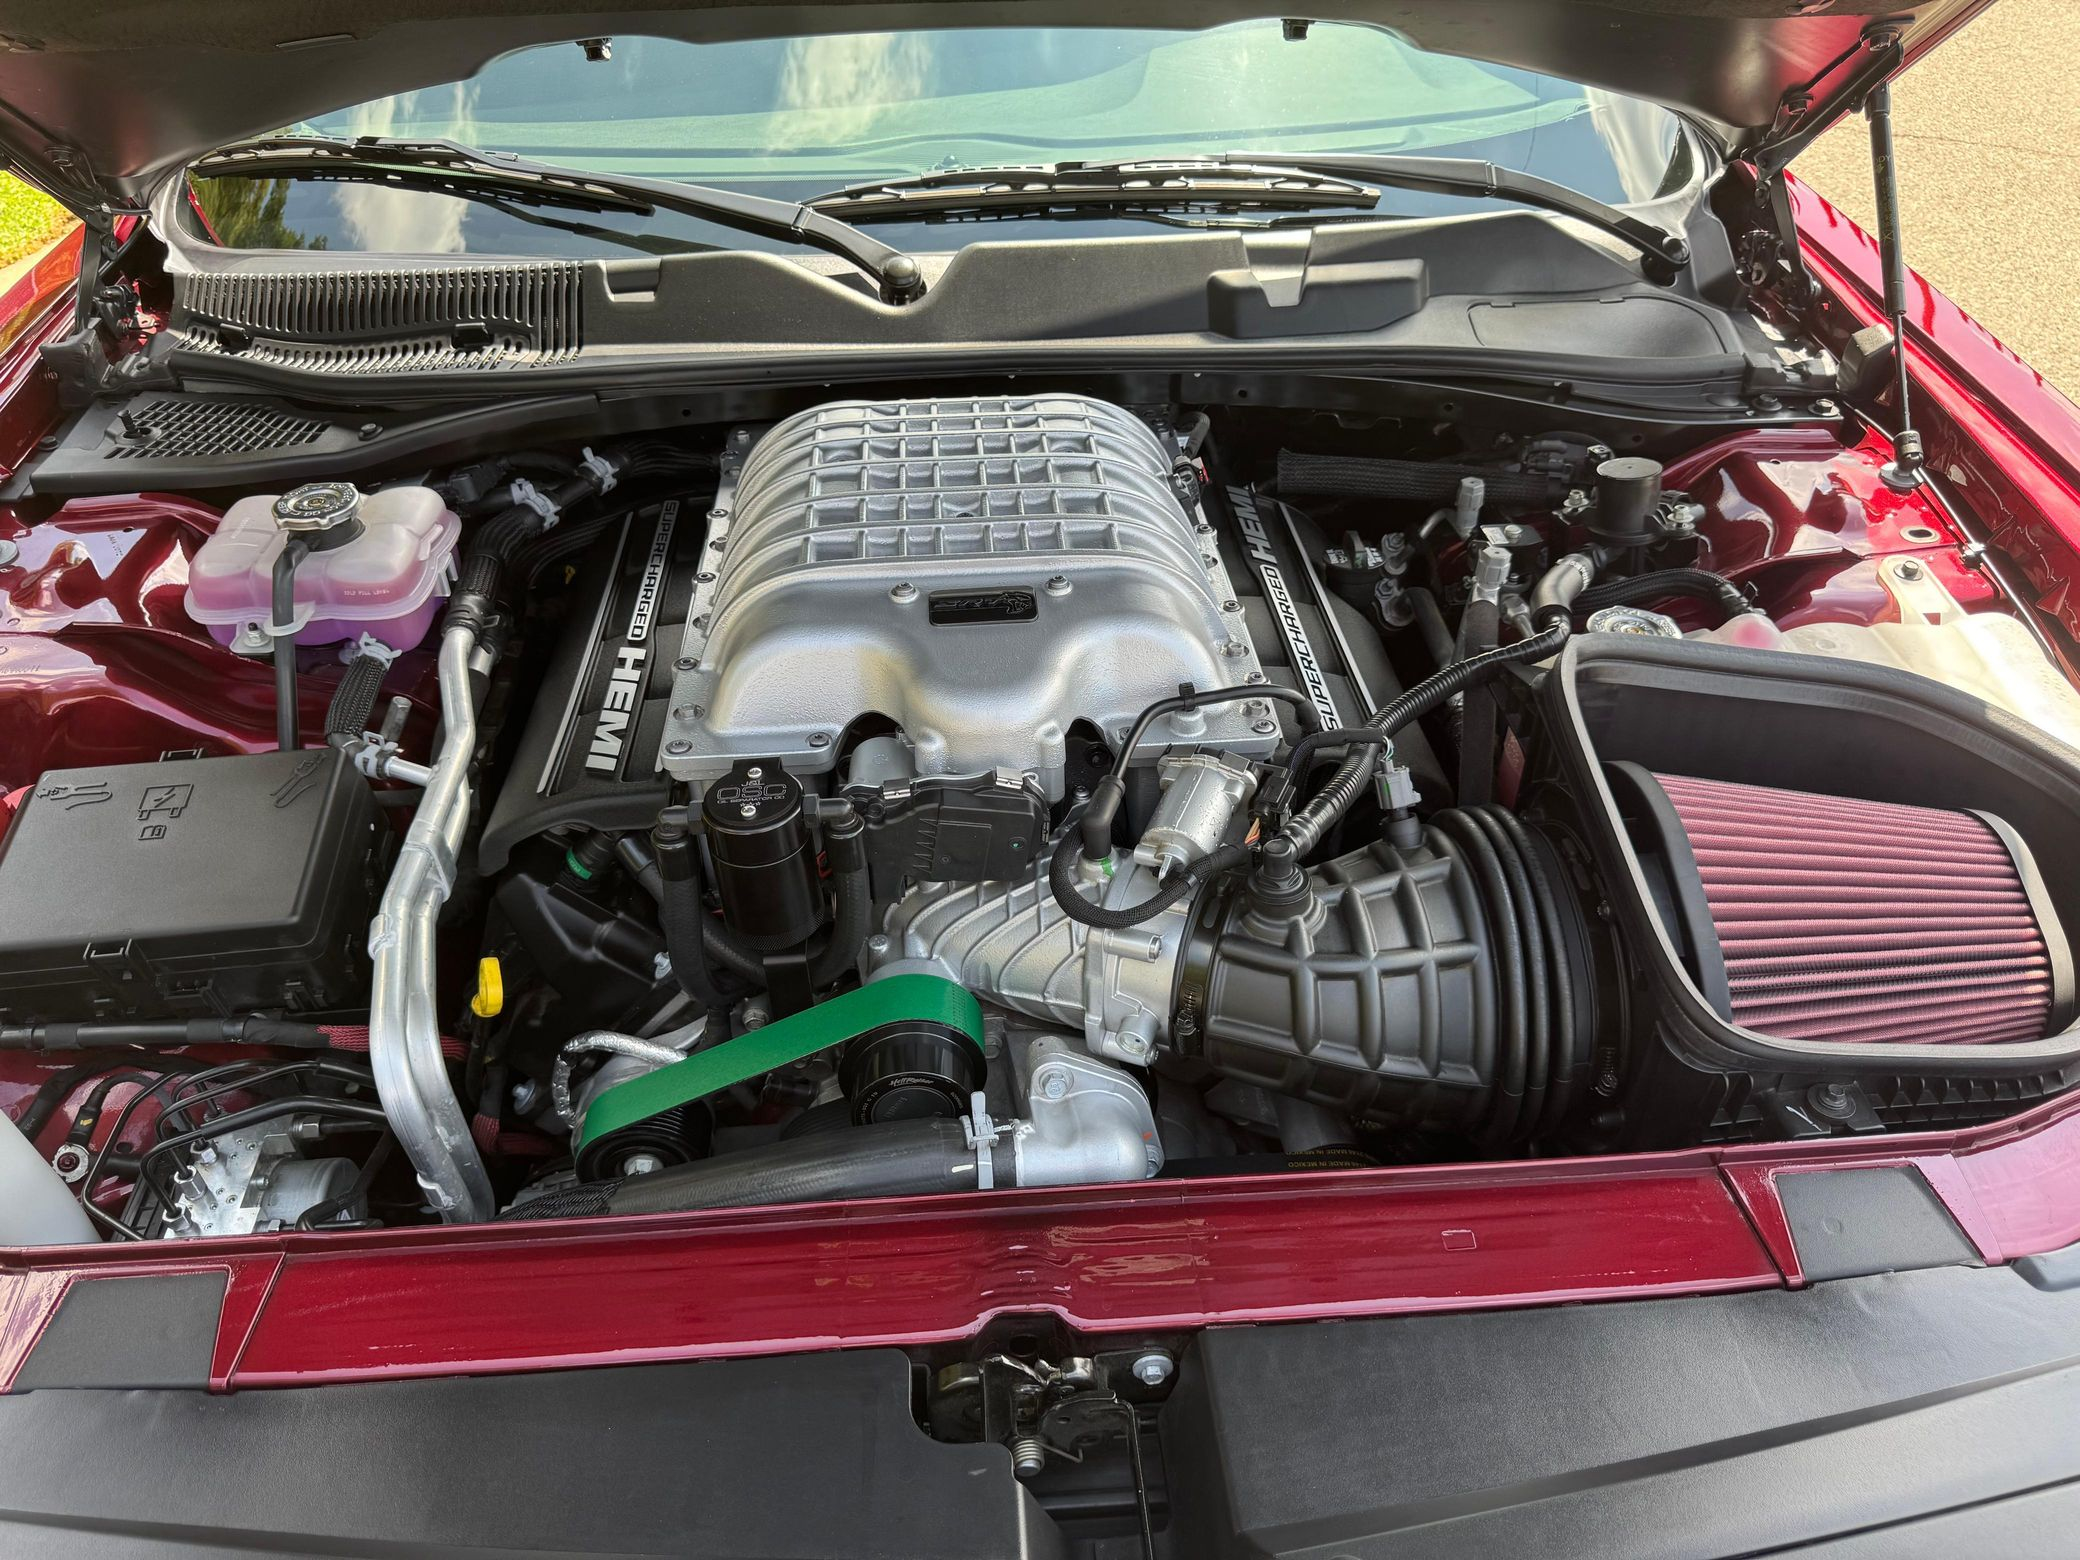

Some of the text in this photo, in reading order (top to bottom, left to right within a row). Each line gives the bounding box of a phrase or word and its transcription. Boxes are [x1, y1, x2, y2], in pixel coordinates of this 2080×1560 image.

[585, 501, 677, 771] SUPERCHARGED HEMI
[1225, 485, 1339, 731] SUPERCHARGED HEMI
[716, 783, 787, 800] OSC
